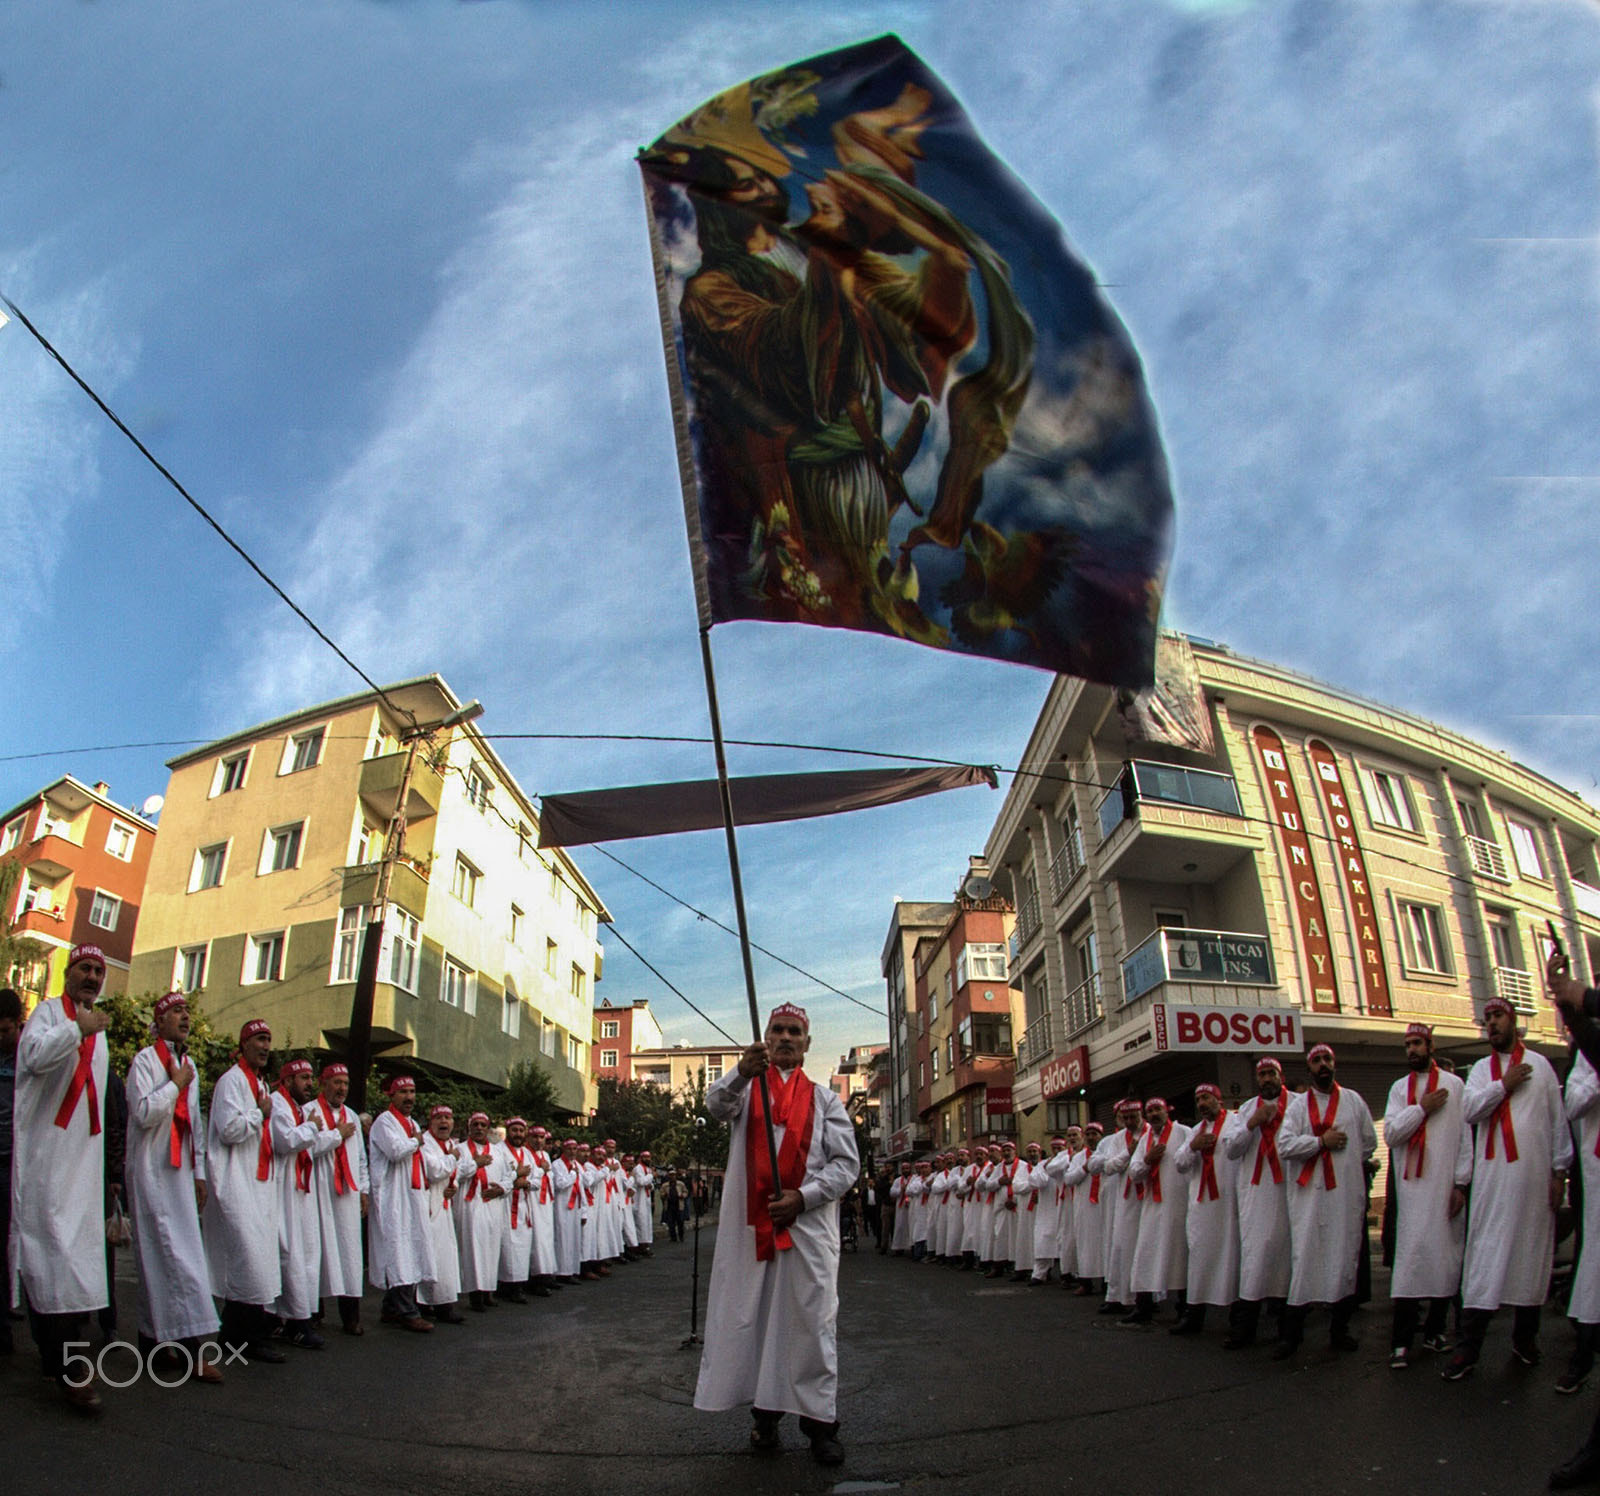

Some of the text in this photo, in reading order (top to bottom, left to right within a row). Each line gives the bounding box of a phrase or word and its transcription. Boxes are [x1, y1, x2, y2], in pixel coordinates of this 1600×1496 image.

[1273, 780, 1326, 975] TUNCAY
[1205, 941, 1262, 958] TUNCAY
[1155, 1005, 1167, 1049] BOSCH
[1176, 1012, 1296, 1045] BOSCH
[1043, 1059, 1080, 1096] aldora
